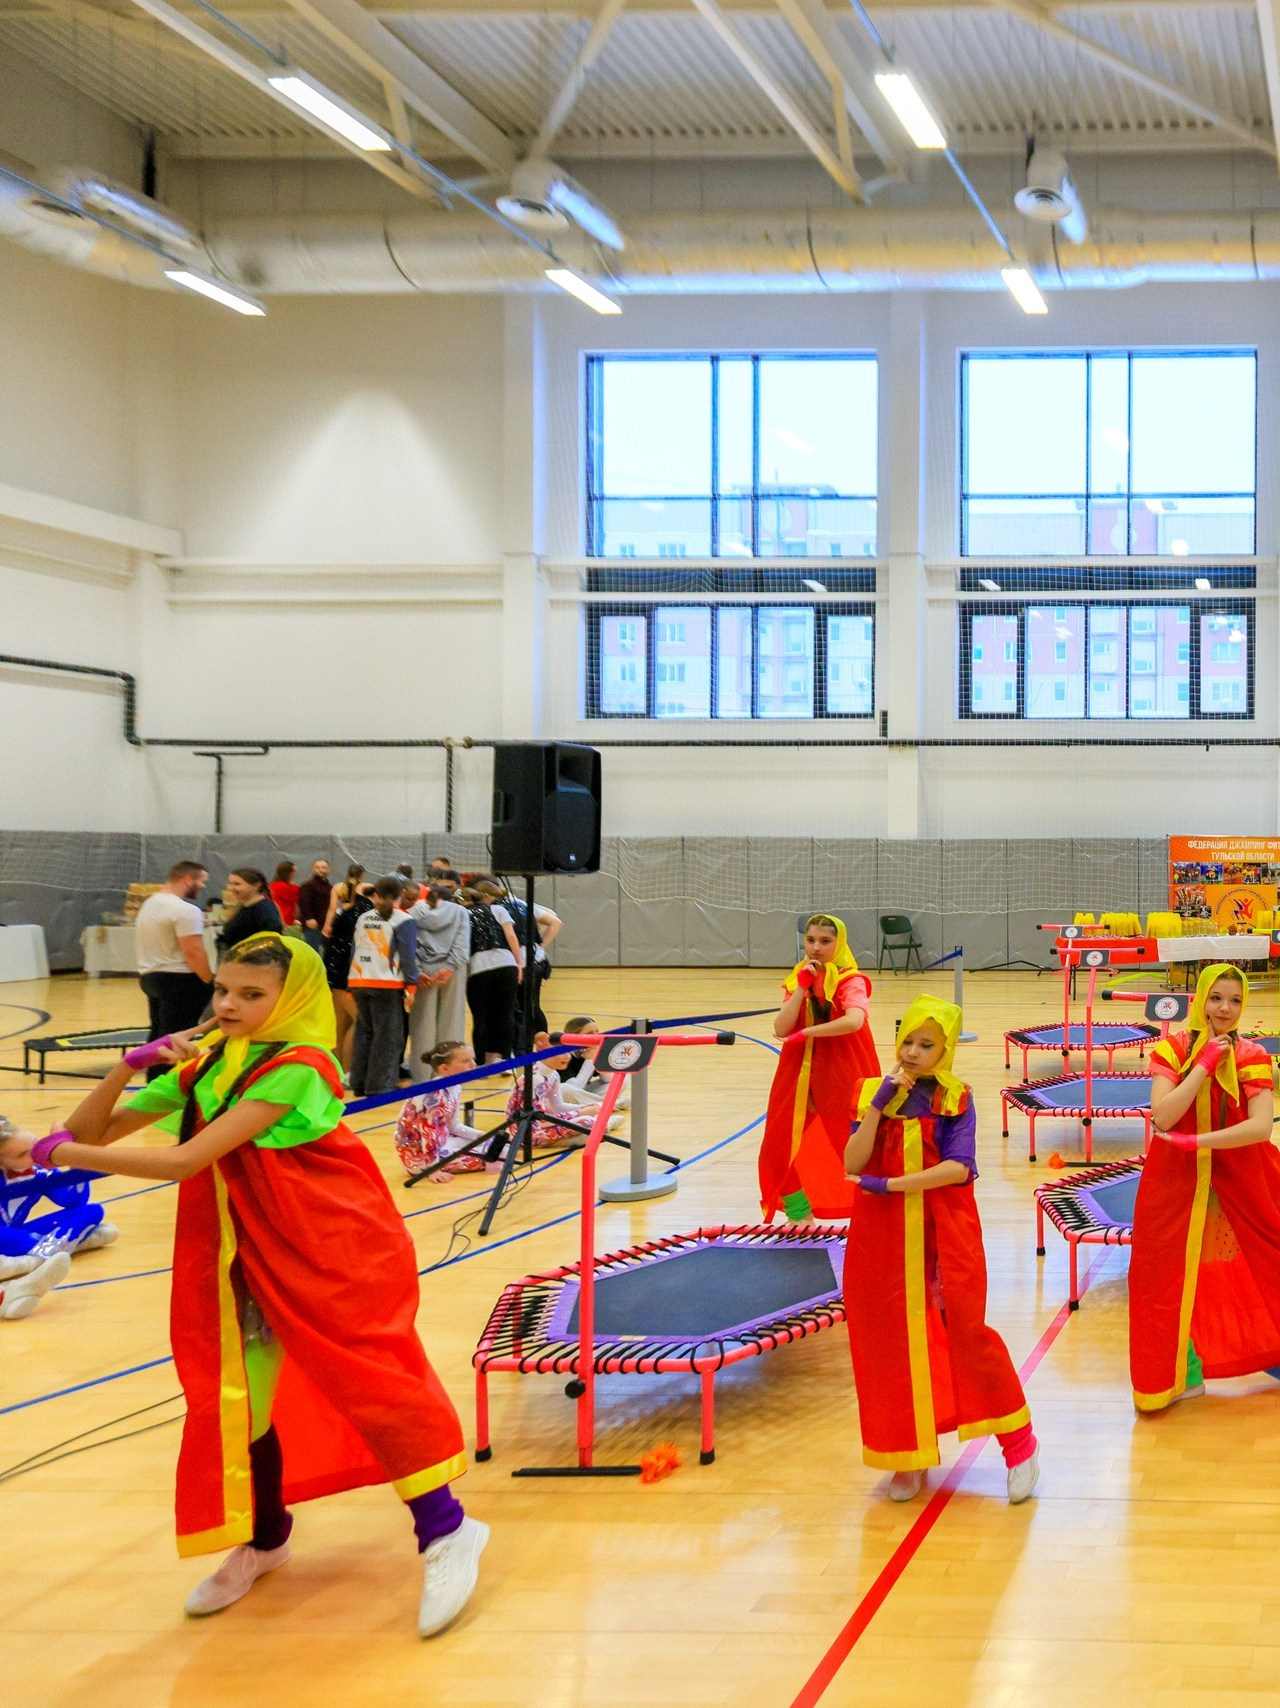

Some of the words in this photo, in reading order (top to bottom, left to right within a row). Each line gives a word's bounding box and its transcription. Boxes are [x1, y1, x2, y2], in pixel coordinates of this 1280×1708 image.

[1188, 840, 1228, 850] ФЕДЕРАЦИЯ
[1229, 841, 1265, 851] ДЖАМПИНГ
[1211, 851, 1245, 861] ТУЛЬСКОЙ
[1246, 852, 1275, 861] ОБЛАСТИ
